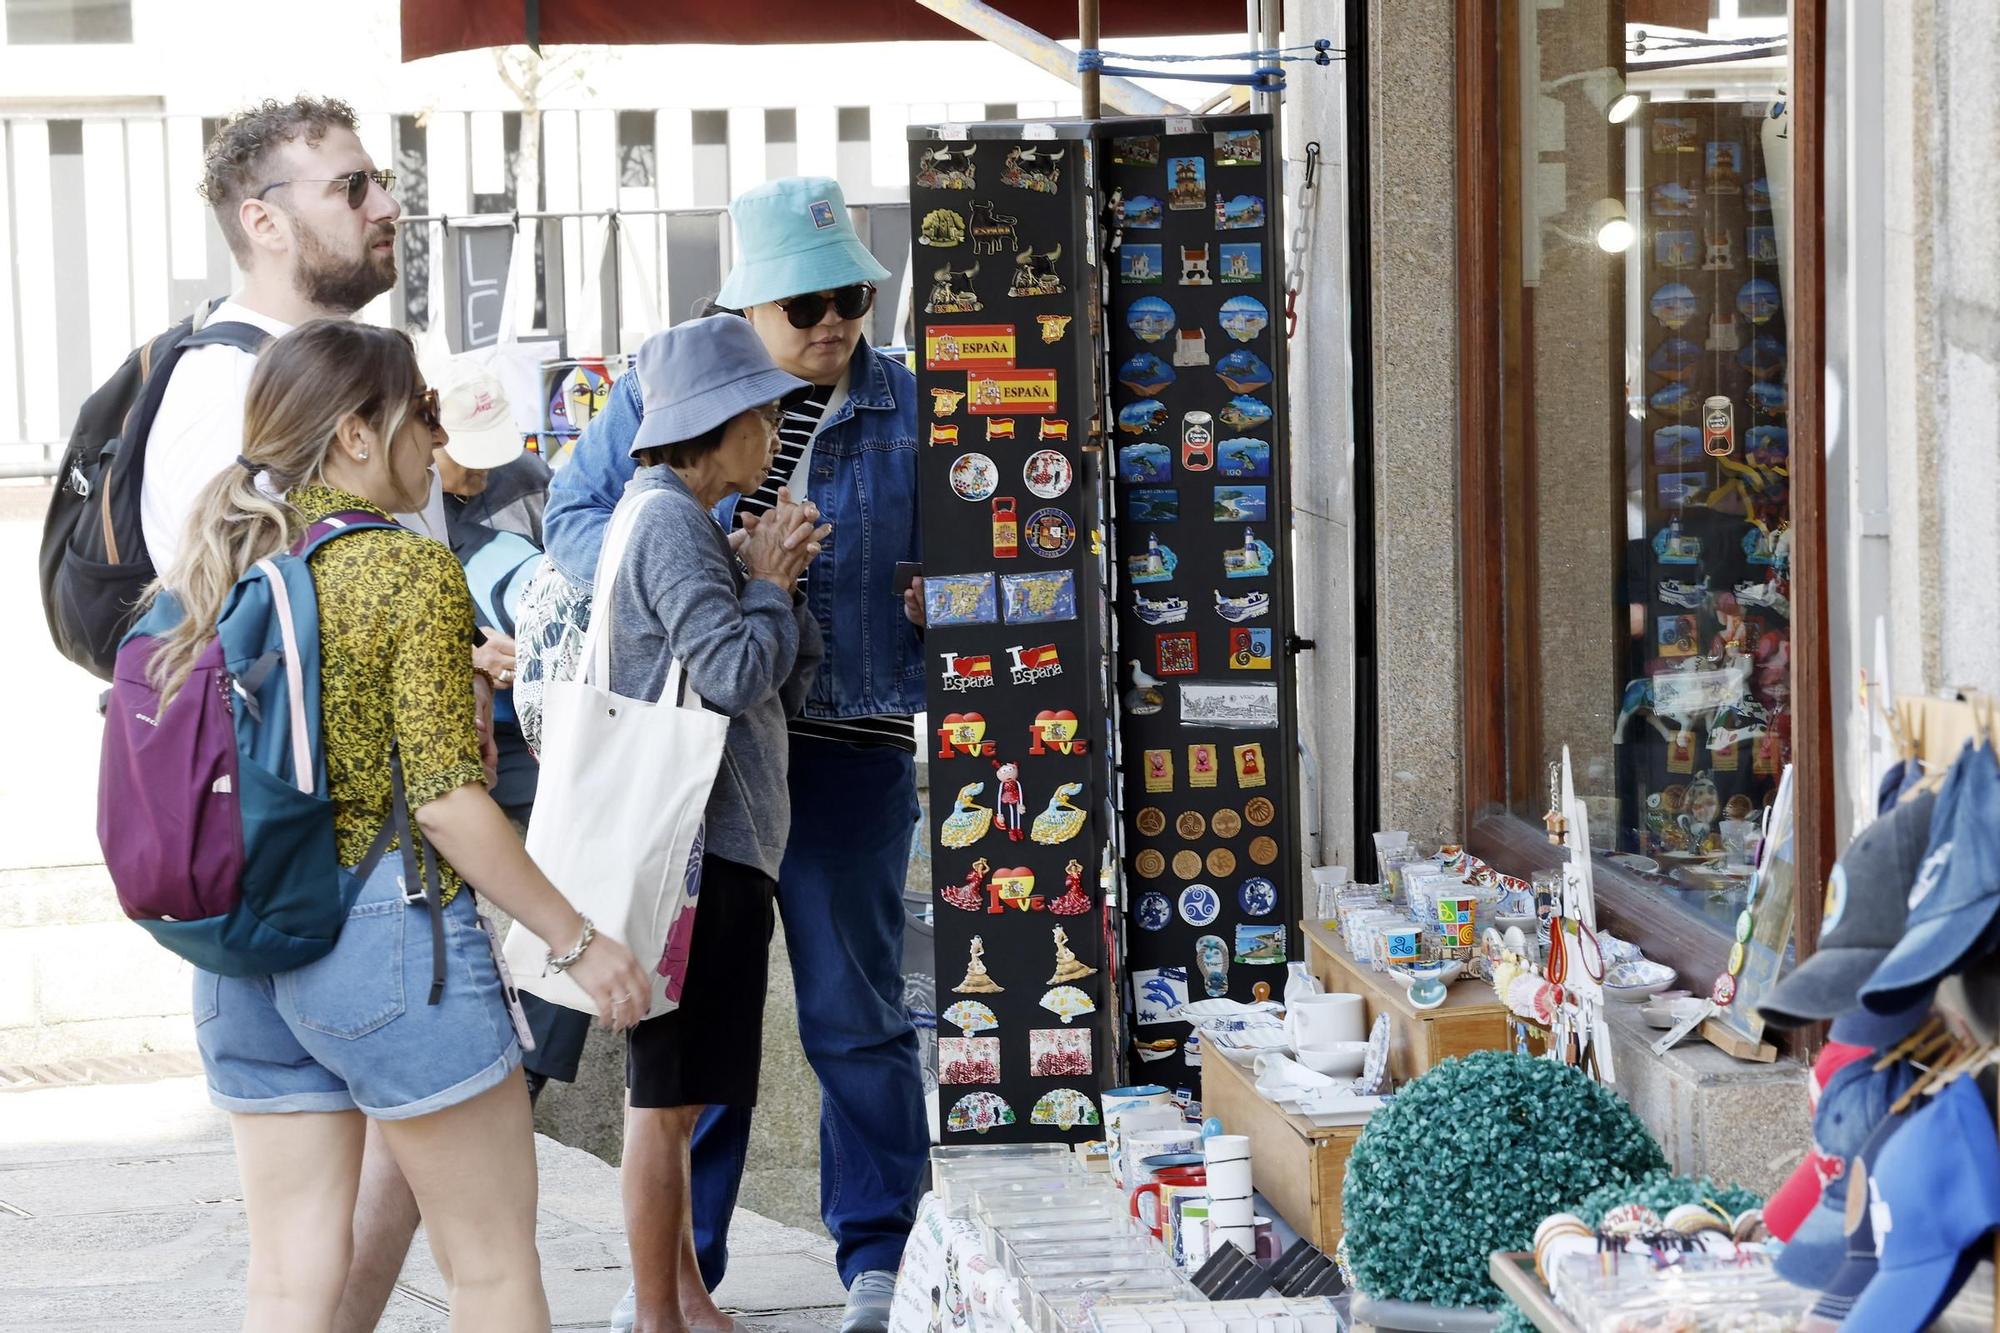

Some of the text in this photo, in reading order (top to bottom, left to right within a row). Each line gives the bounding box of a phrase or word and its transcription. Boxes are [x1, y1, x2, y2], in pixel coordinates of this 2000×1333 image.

[962, 340, 1008, 354] ESPAÑA
[1004, 385, 1049, 398] ESPAÑA
[940, 652, 960, 678] I
[1005, 645, 1025, 673] I
